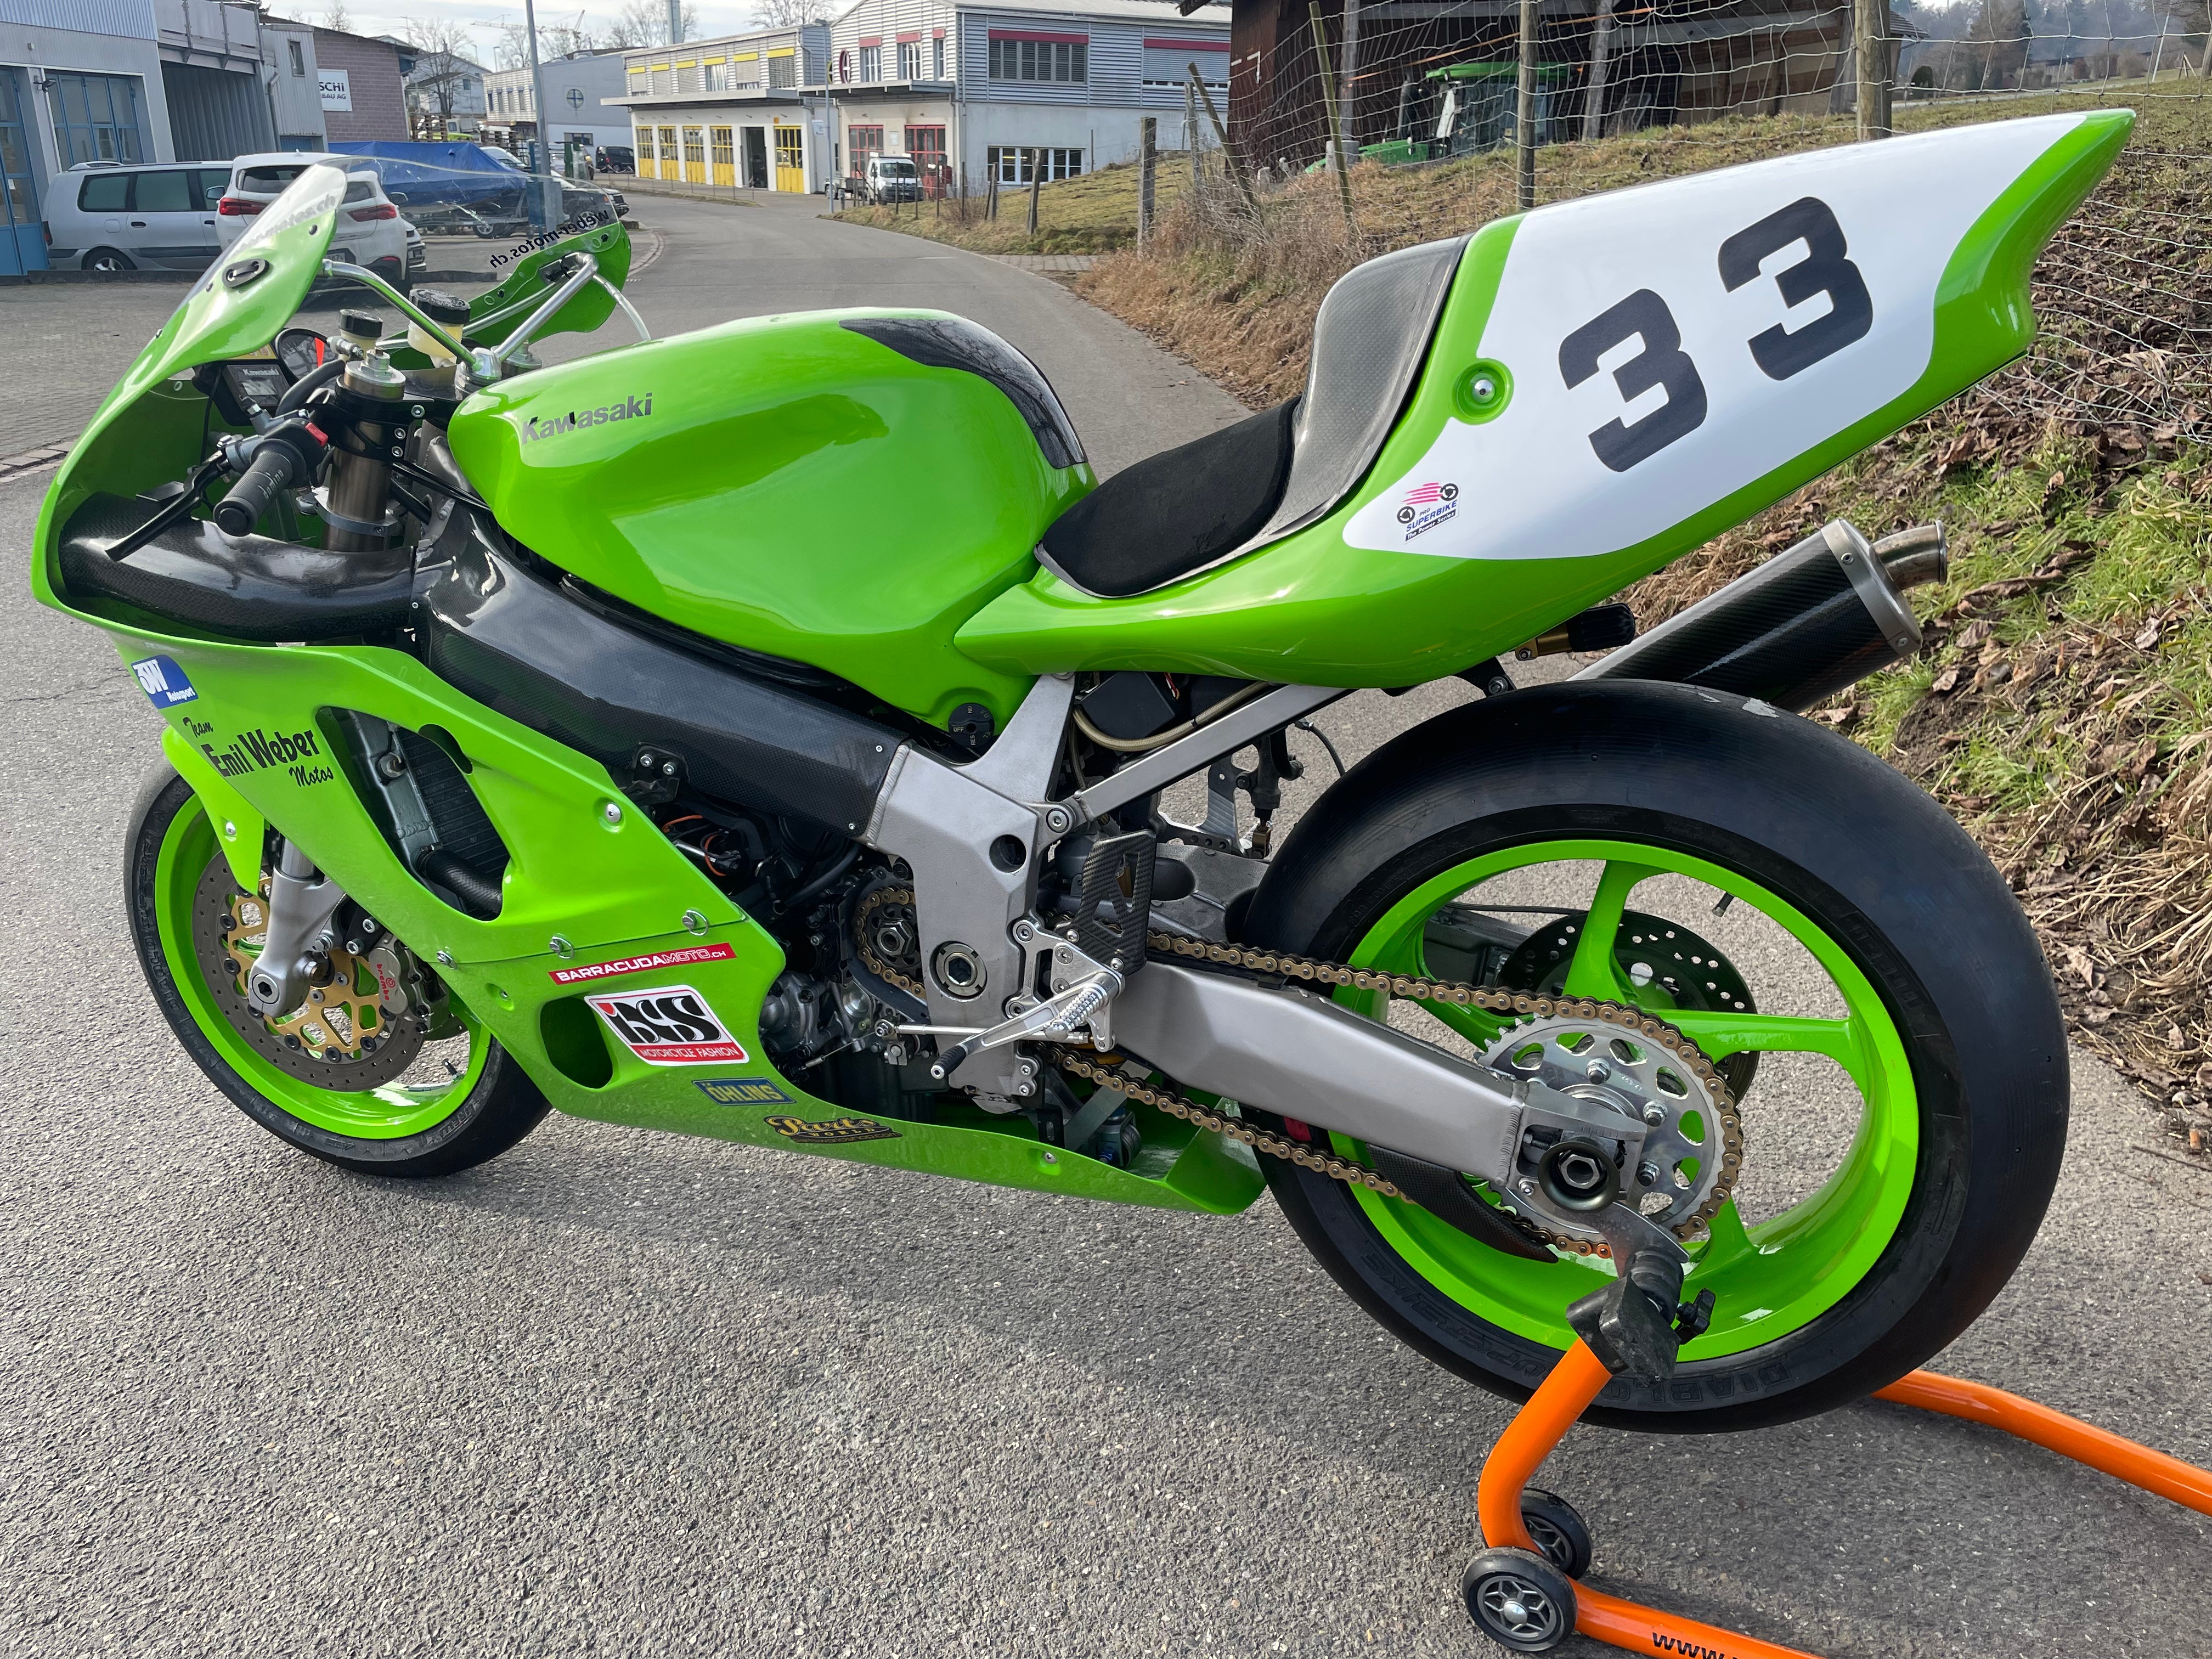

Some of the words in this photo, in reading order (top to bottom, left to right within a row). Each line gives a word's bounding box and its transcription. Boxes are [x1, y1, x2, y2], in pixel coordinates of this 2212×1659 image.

[522, 392, 653, 445] Kawasaki
[257, 469, 284, 500] domino
[1406, 499, 1458, 532] SUPERBIKE
[1418, 522, 1436, 533] Power
[1437, 512, 1454, 524] Series
[1419, 507, 1431, 516] PRO
[182, 716, 213, 738] Team
[200, 743, 255, 777] Emil
[236, 729, 320, 769] Weber
[289, 765, 334, 787] Motos
[556, 949, 727, 982] BARRACUDAMOTO.CH
[376, 964, 390, 1001] brembo
[640, 1047, 695, 1058] MOTORCYCLE
[696, 1046, 740, 1058] FASHION
[702, 1082, 785, 1102] ÖHLINS
[767, 1117, 876, 1136] Parts
[808, 1127, 876, 1137] WORLD
[1359, 1254, 1549, 1376] UPERBIKE
